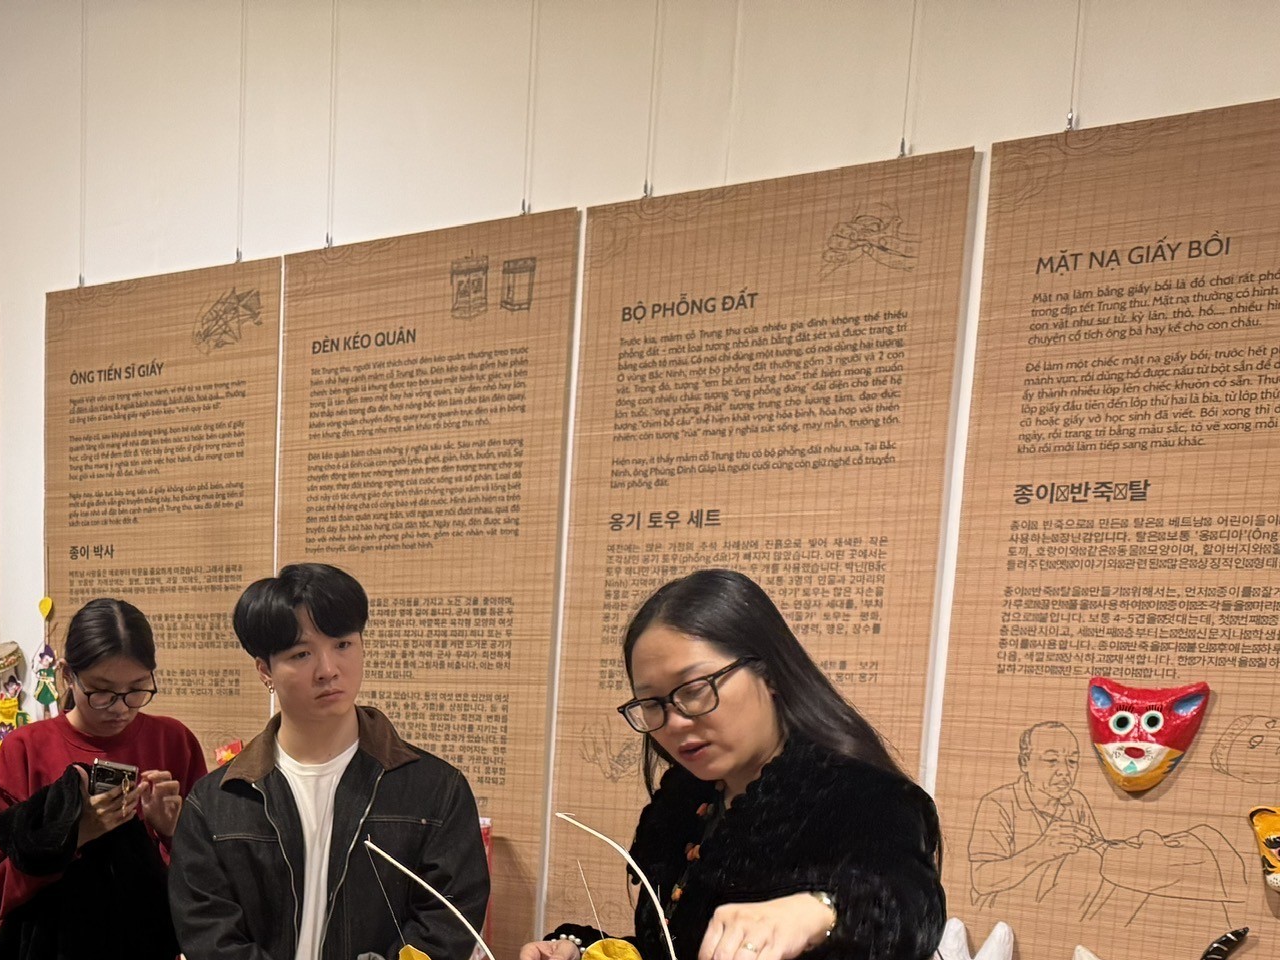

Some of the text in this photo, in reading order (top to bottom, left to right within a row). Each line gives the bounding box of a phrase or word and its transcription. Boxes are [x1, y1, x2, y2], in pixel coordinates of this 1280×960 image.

[1036, 230, 1230, 276] MẶT NẠ GIẤY BỒI
[622, 286, 759, 324] BỘ PHỖNG ĐẤT
[312, 326, 416, 354] ĐÈN KÉO QUÂN
[70, 358, 164, 385] ÔNG TIẾN SĨ GIẤY
[609, 508, 721, 531] 옹기 토우 세트
[69, 544, 114, 560] 종이 박사
